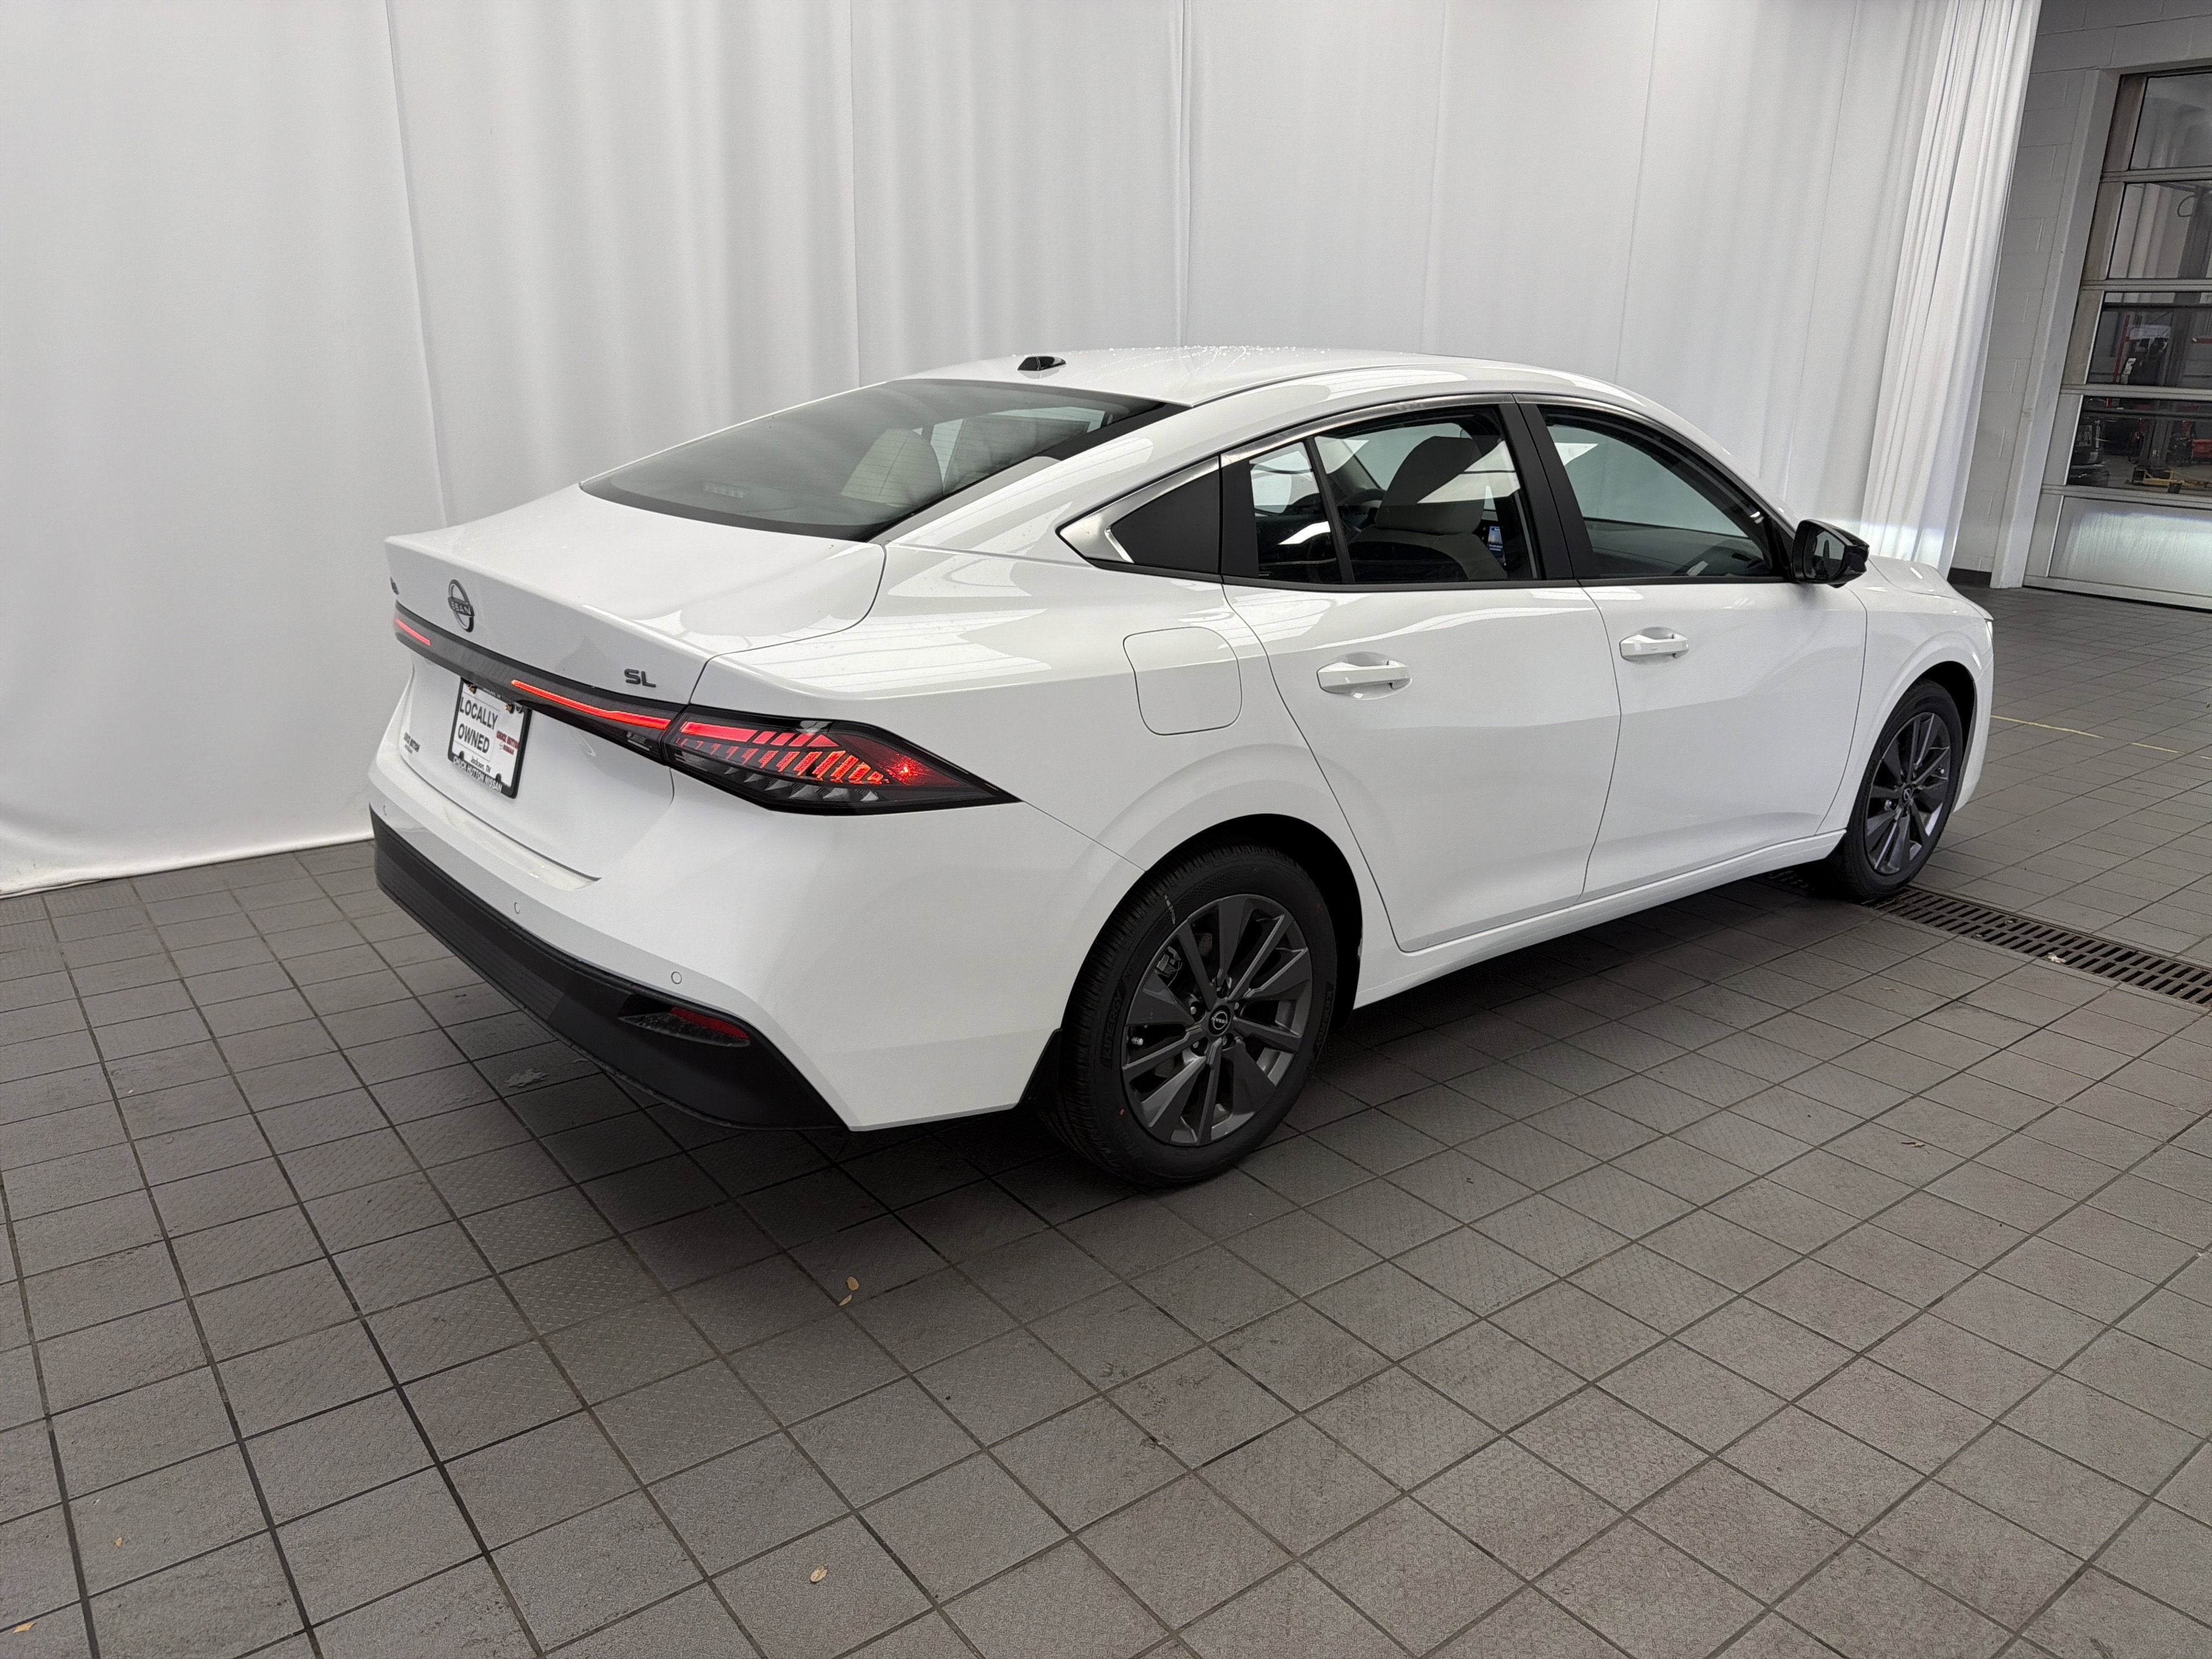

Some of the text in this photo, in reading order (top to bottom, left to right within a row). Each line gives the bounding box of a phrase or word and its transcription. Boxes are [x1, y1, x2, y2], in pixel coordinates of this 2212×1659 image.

[450, 600, 472, 615] SSAN
[624, 668, 657, 689] SL
[460, 696, 499, 730] LOCALLY
[458, 723, 490, 753] OWNED
[507, 736, 518, 749] HUTTO
[453, 756, 503, 793] CHUCK HUTTON NISSAN
[486, 765, 492, 774] TN
